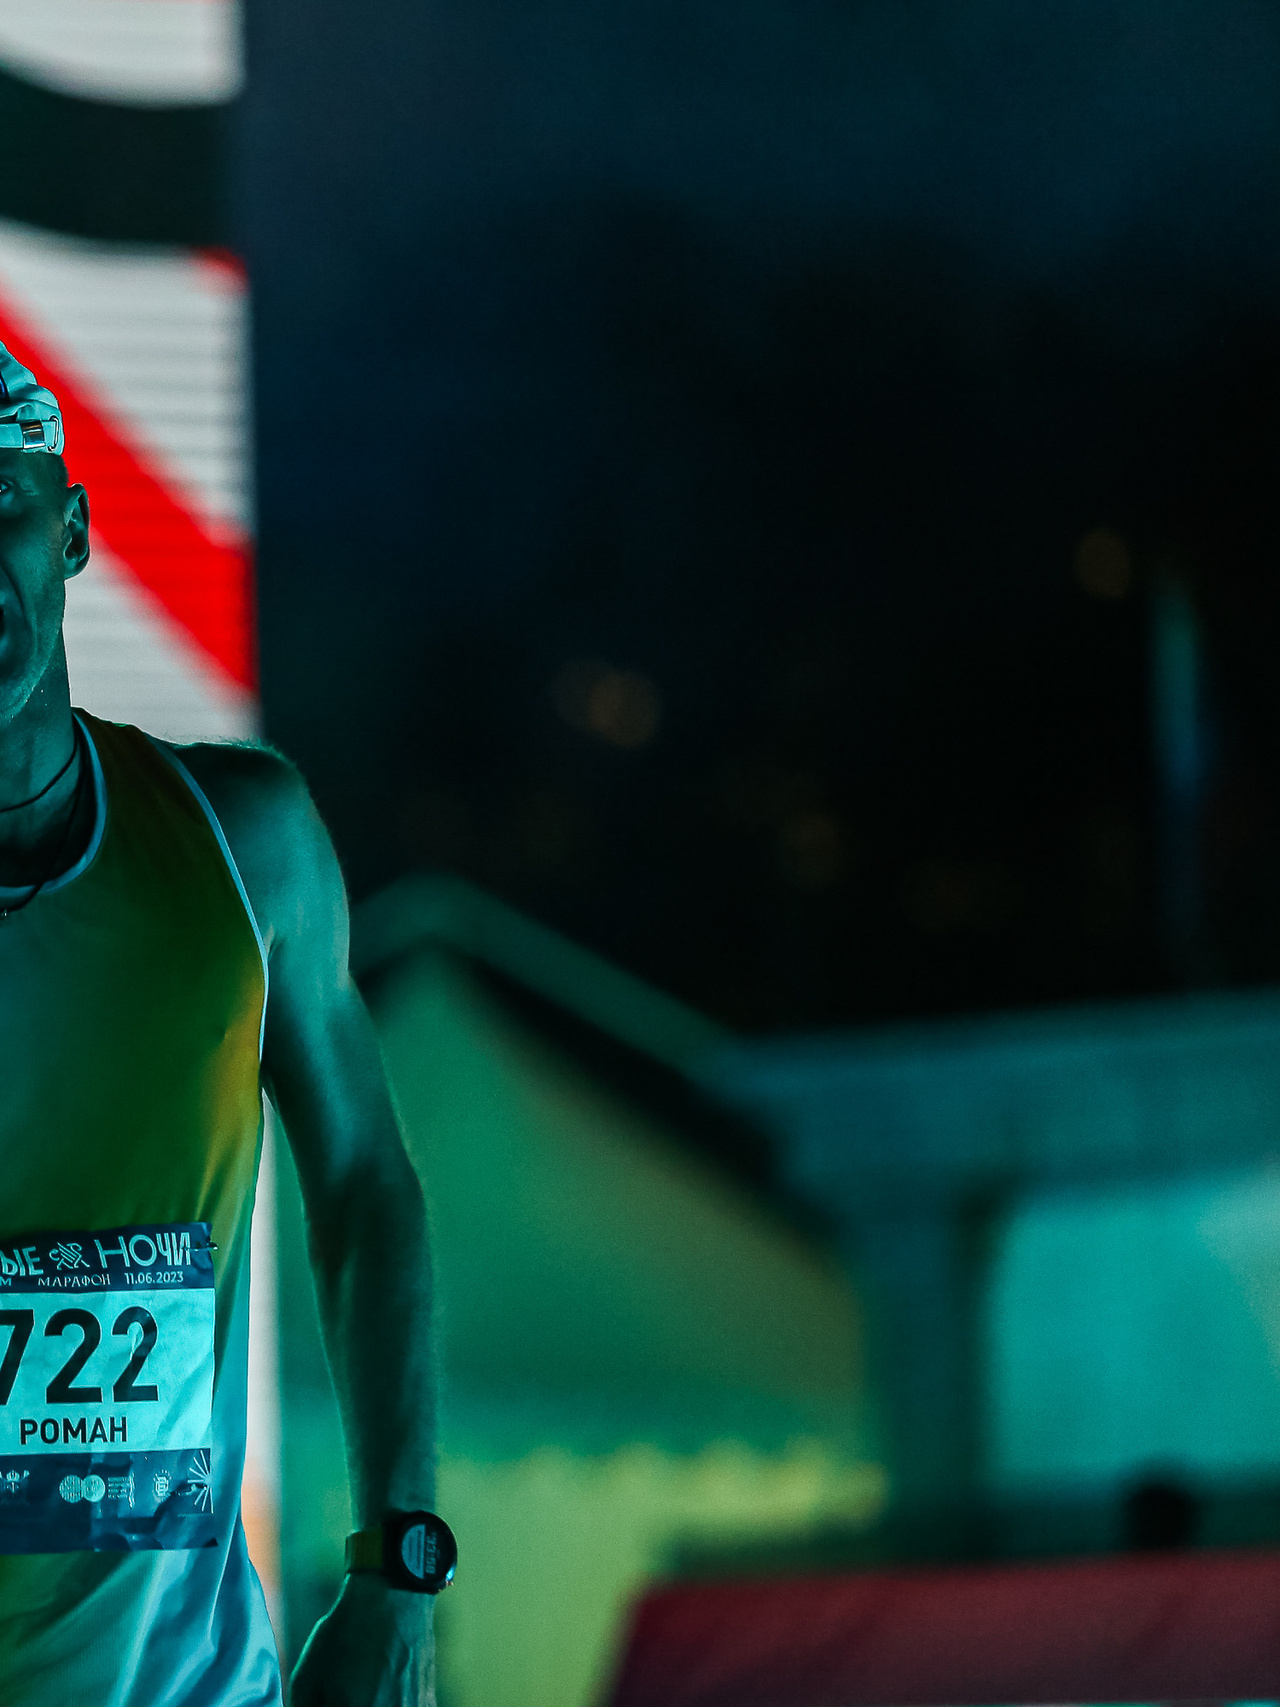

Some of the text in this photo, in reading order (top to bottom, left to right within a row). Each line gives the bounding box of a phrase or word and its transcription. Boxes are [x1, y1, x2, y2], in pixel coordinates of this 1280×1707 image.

[94, 1231, 193, 1269] НОЧИ
[37, 1273, 112, 1288] МАРАФОН
[124, 1270, 185, 1286] 11.06.2023
[19, 1416, 128, 1446] РОМАН
